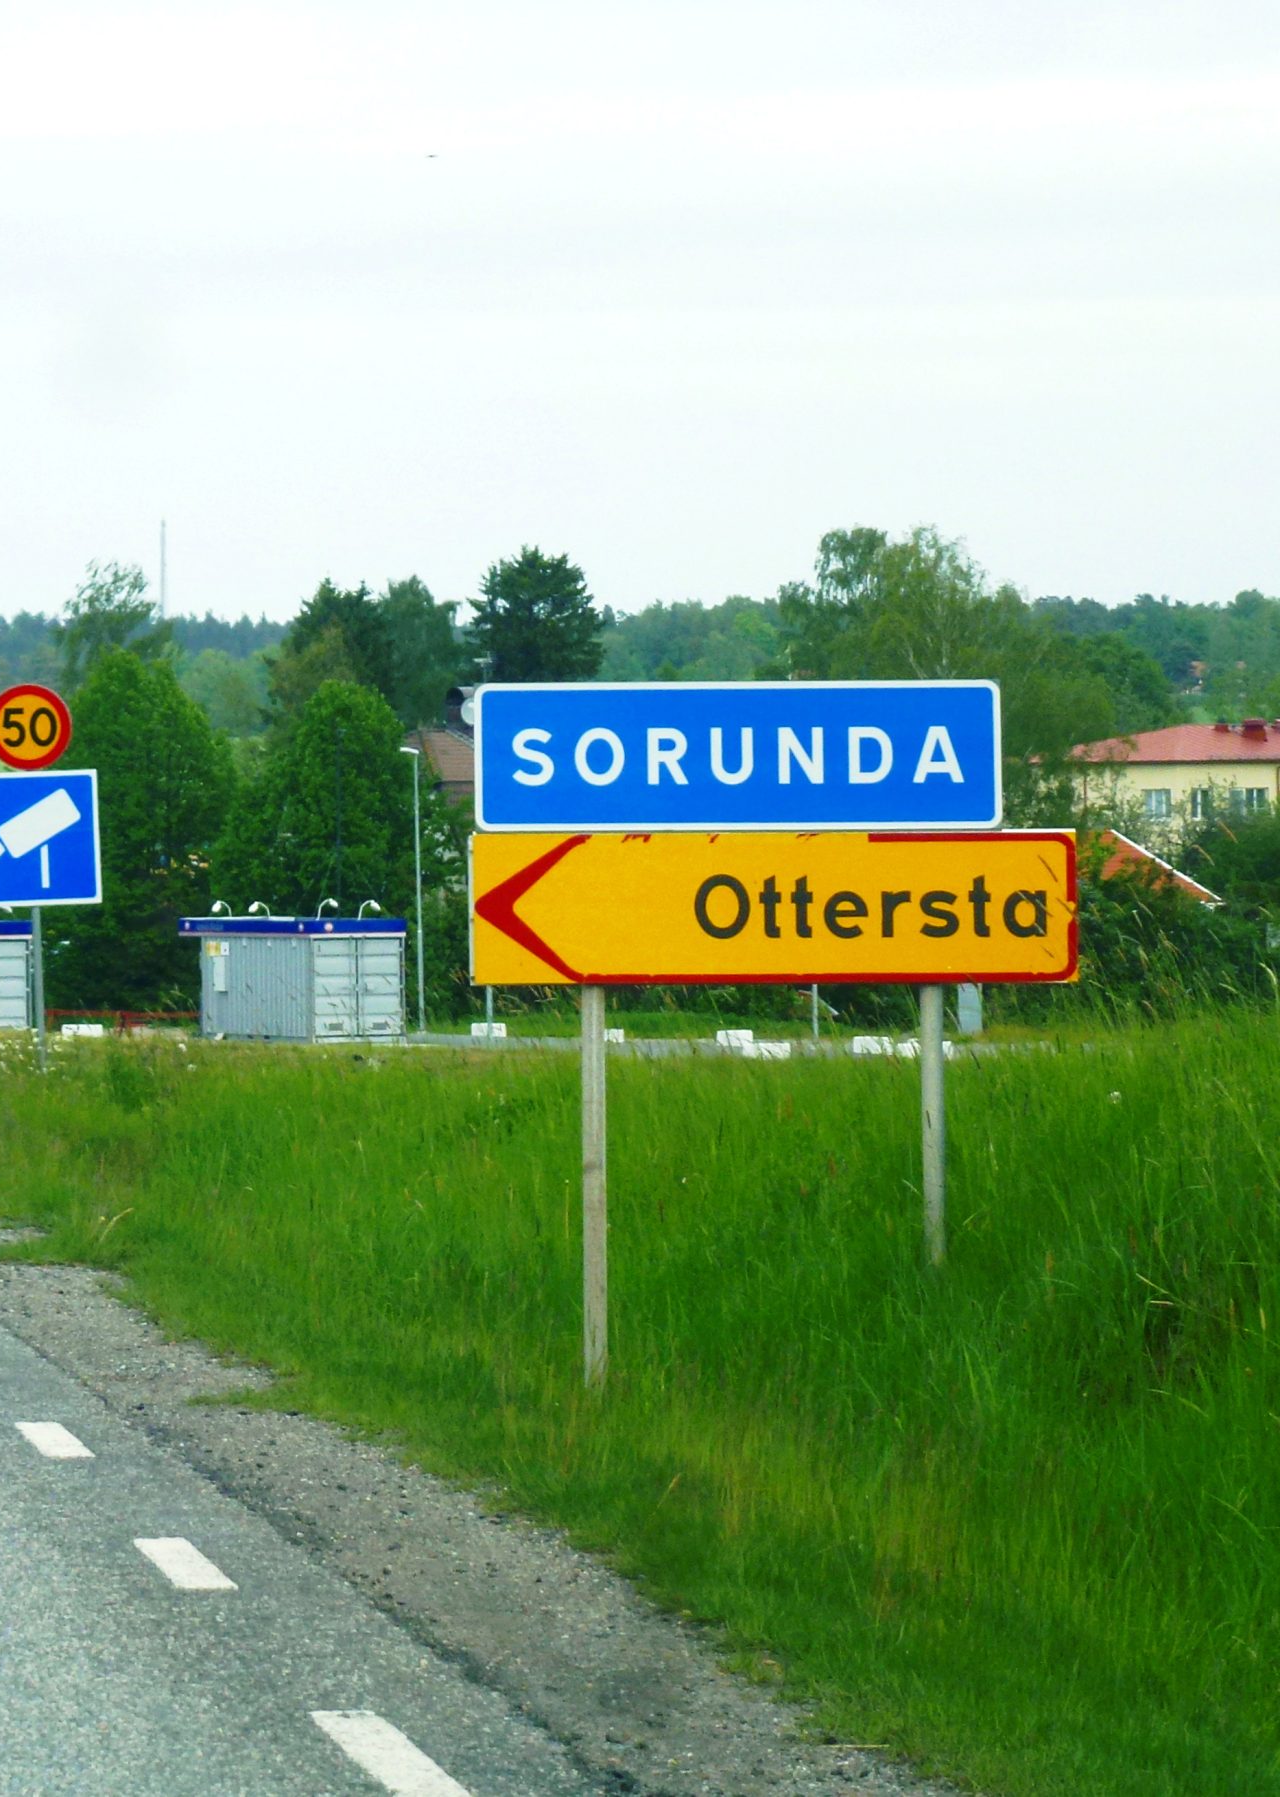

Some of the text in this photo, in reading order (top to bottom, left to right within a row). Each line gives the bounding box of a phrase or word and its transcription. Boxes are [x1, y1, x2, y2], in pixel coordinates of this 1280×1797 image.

[3, 707, 57, 747] 50
[512, 726, 965, 786] SORUNDA
[694, 874, 1048, 940] Ottersta
